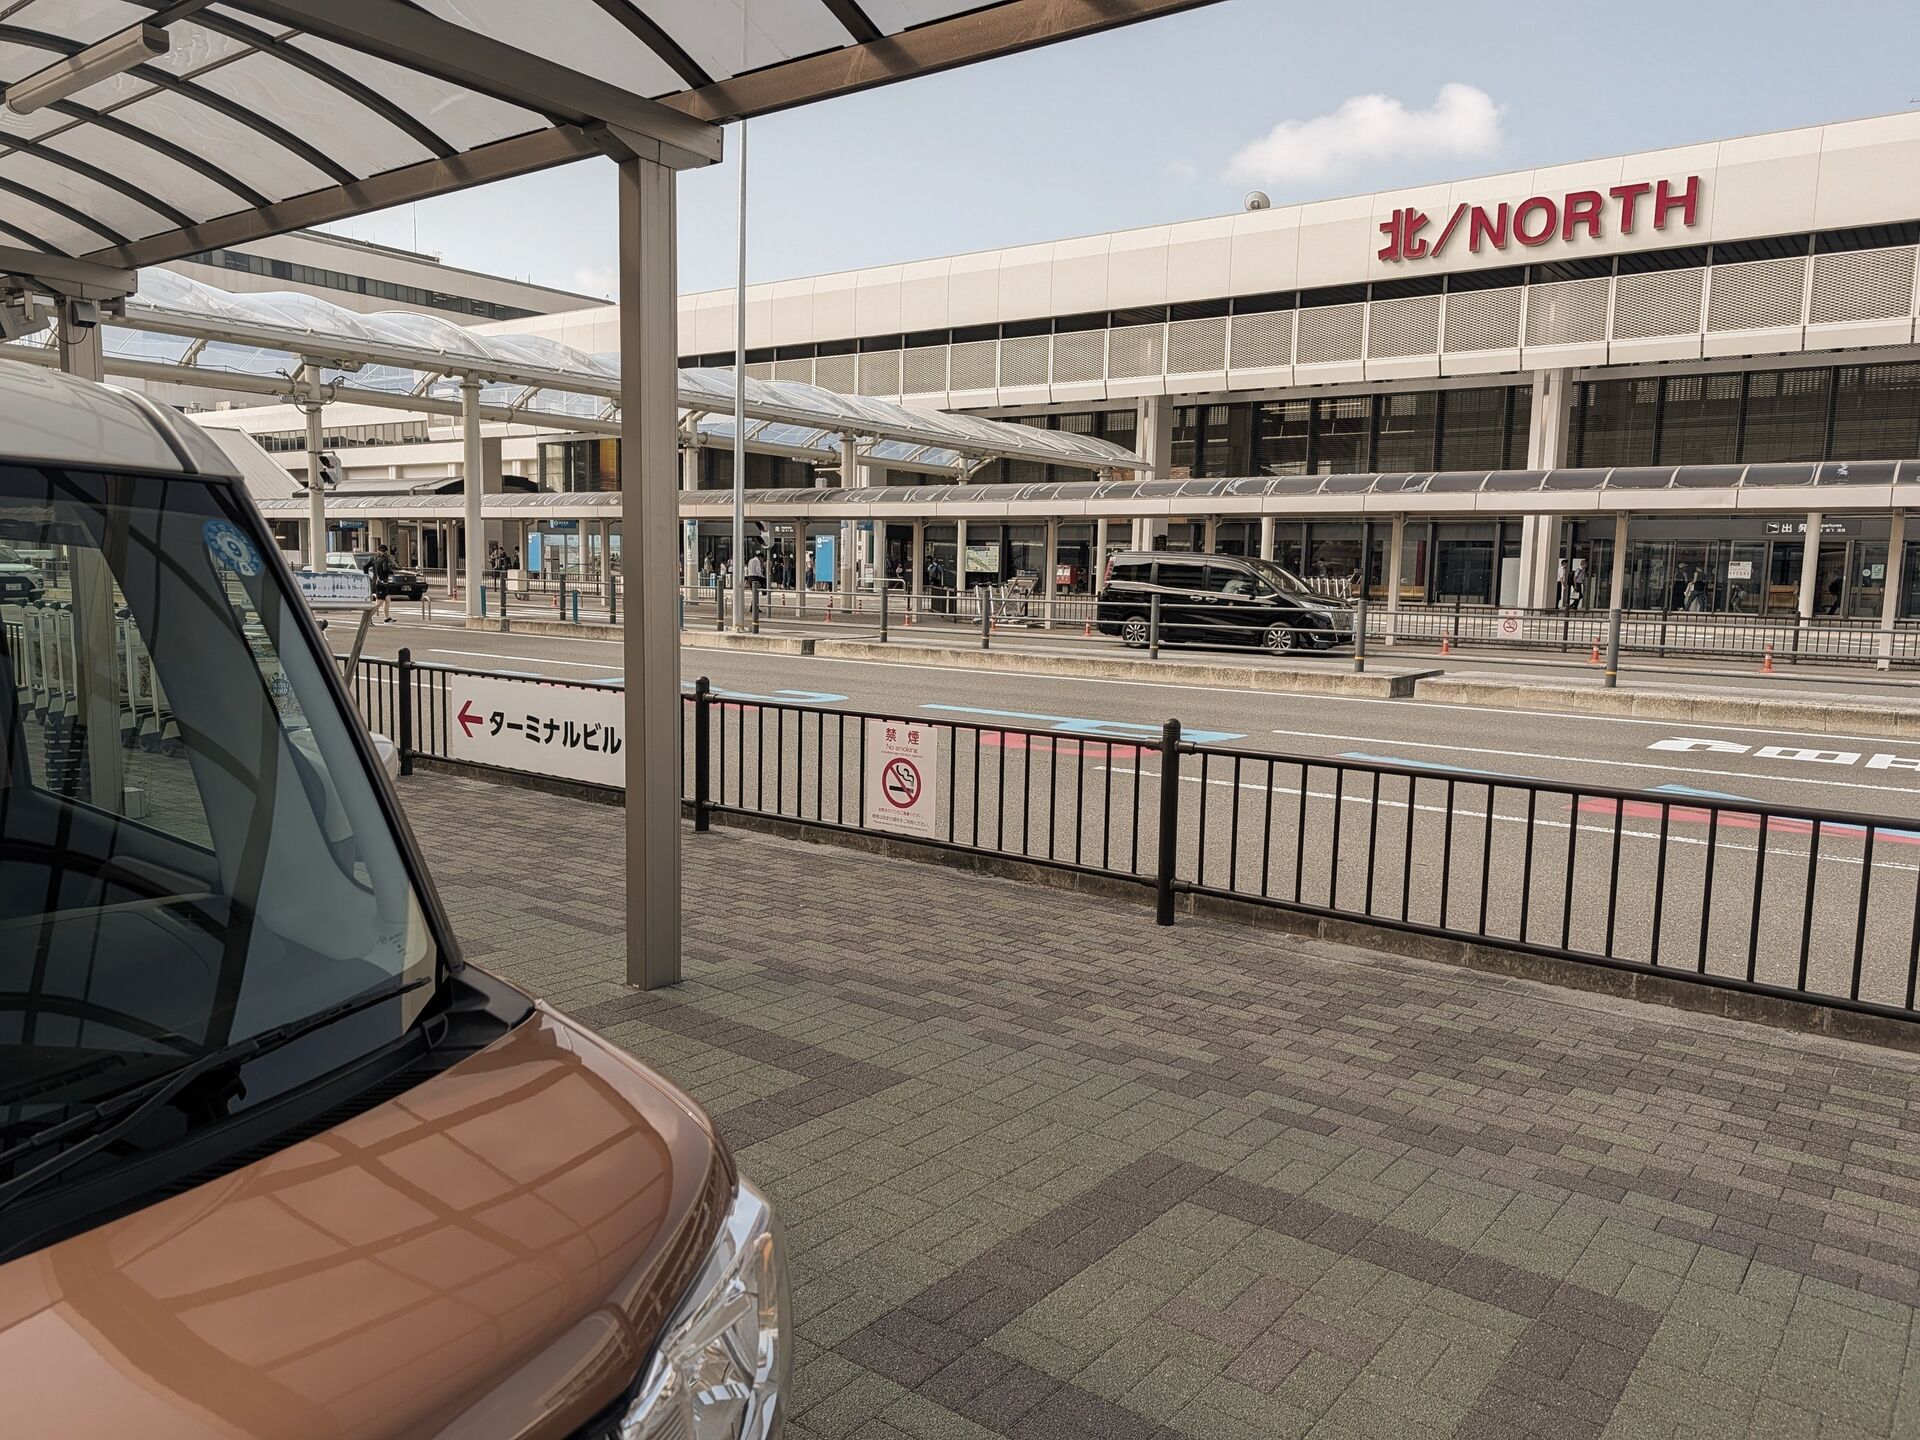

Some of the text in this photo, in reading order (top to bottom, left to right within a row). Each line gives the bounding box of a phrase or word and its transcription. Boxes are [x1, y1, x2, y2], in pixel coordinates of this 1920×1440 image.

[489, 711, 622, 755] ターミナルビル
[885, 743, 895, 751] No
[895, 745, 919, 754] smoking
